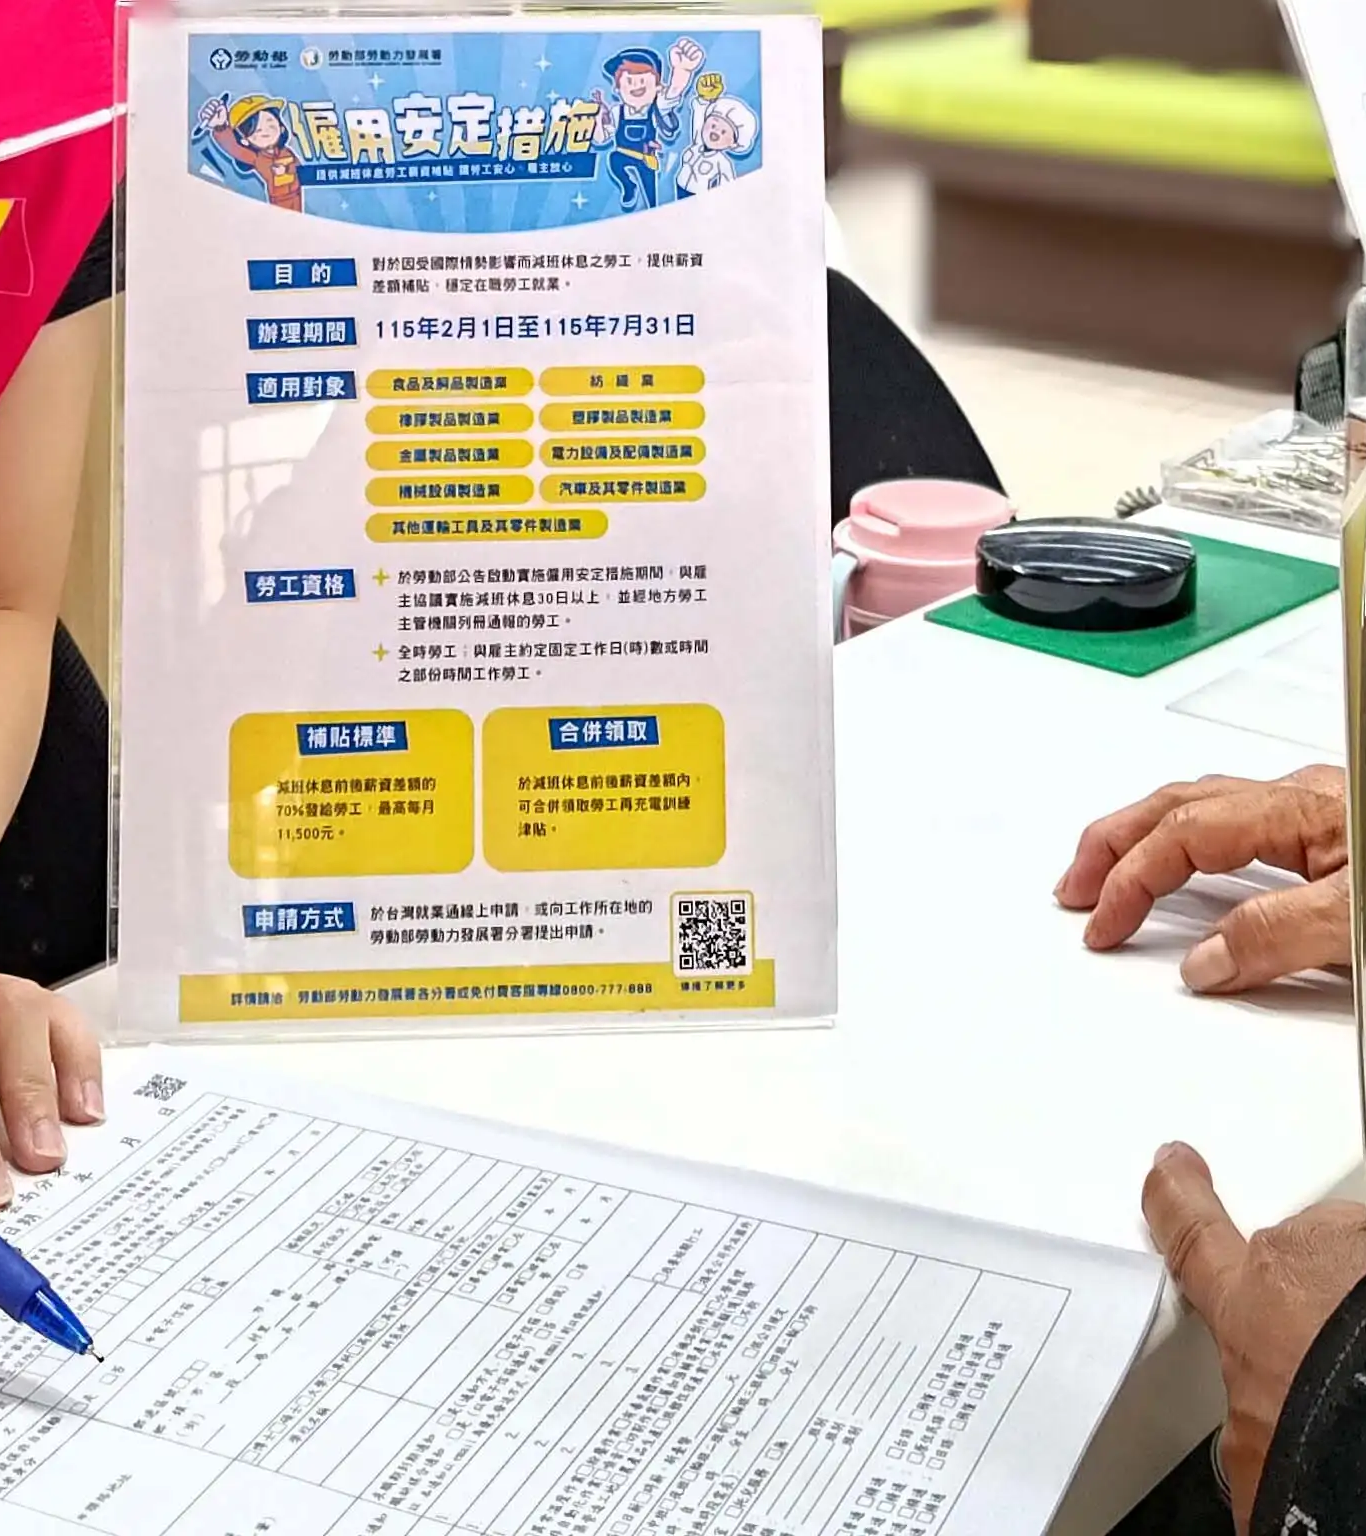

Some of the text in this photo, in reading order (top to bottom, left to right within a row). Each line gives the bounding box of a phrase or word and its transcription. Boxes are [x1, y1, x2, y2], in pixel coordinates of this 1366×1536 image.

[289, 90, 600, 165] 僱用安定措施
[257, 320, 347, 345] 辦理期間
[375, 313, 696, 340] 115年2月1日至115年7月31日
[256, 375, 347, 399] 適用對象
[255, 572, 346, 598] 勞工資格
[306, 725, 398, 750] 補貼標準
[558, 719, 648, 744] 合併領取
[254, 906, 345, 932] 申請方式
